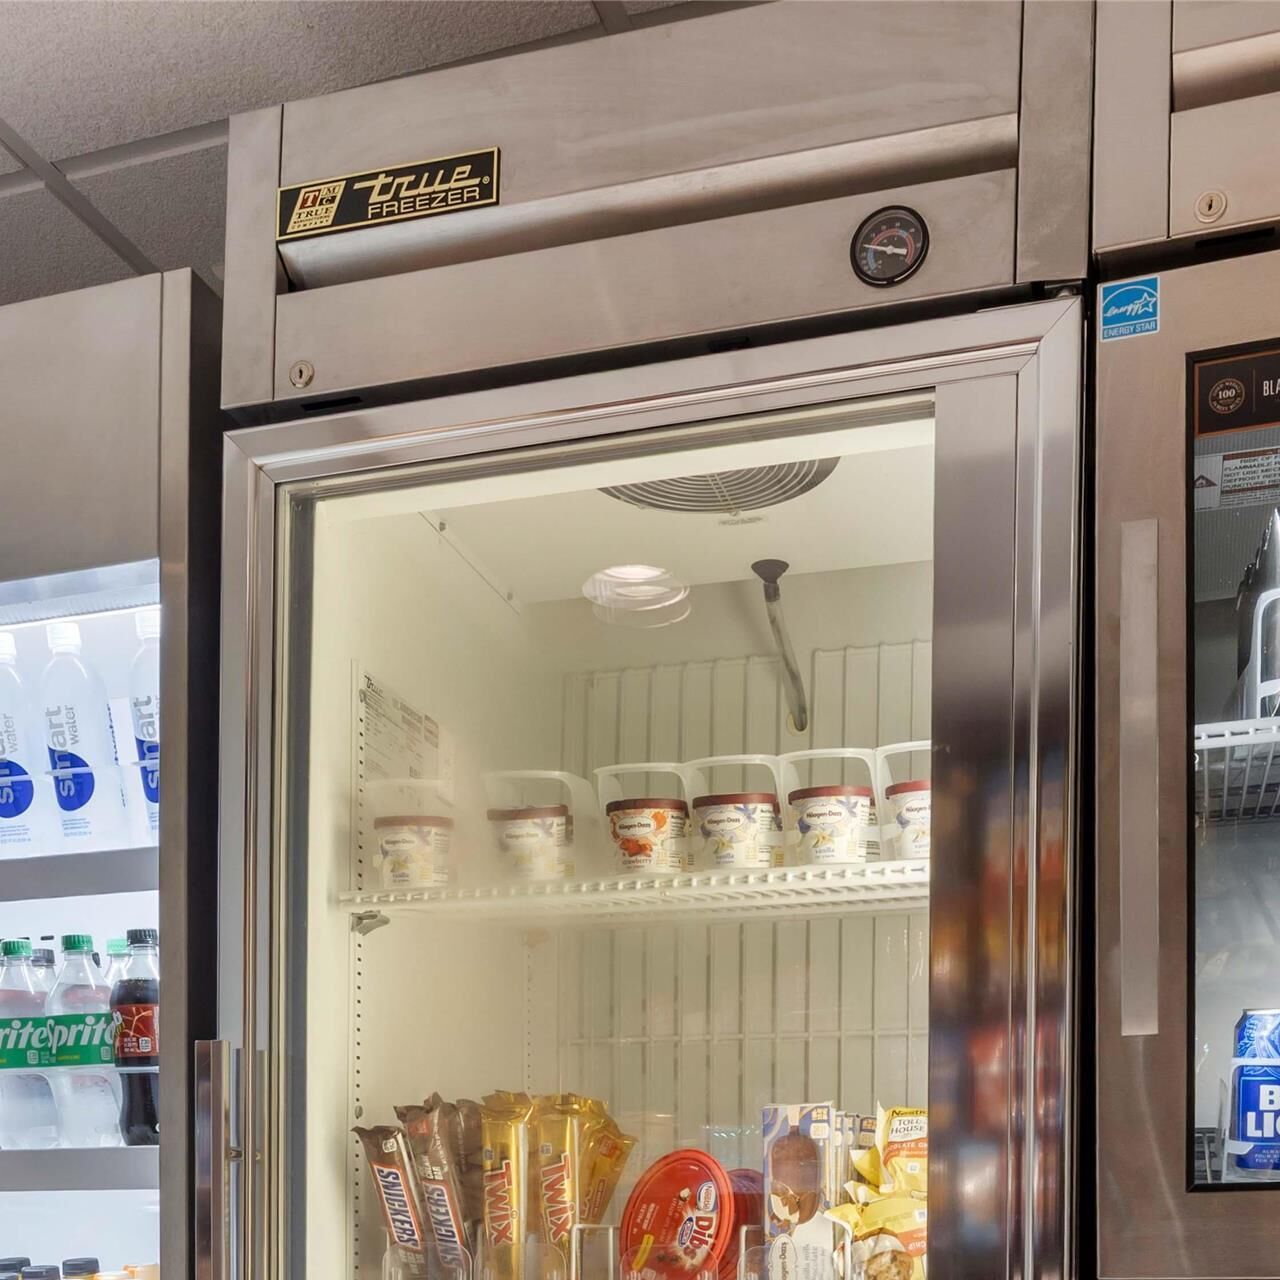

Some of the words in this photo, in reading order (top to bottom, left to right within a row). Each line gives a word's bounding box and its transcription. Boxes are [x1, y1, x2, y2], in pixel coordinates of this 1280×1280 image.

[296, 205, 334, 220] TRUE
[367, 186, 480, 219] FREEZER
[1104, 325, 1135, 338] ENERGY
[1135, 320, 1156, 333] STAR
[2, 713, 19, 754] water
[45, 705, 76, 797] smart
[64, 704, 80, 746] water
[376, 1166, 420, 1249] SNICKERS
[424, 1184, 463, 1268] SNICKERS
[484, 1158, 515, 1248] TWIX
[541, 1152, 572, 1243] TWIX
